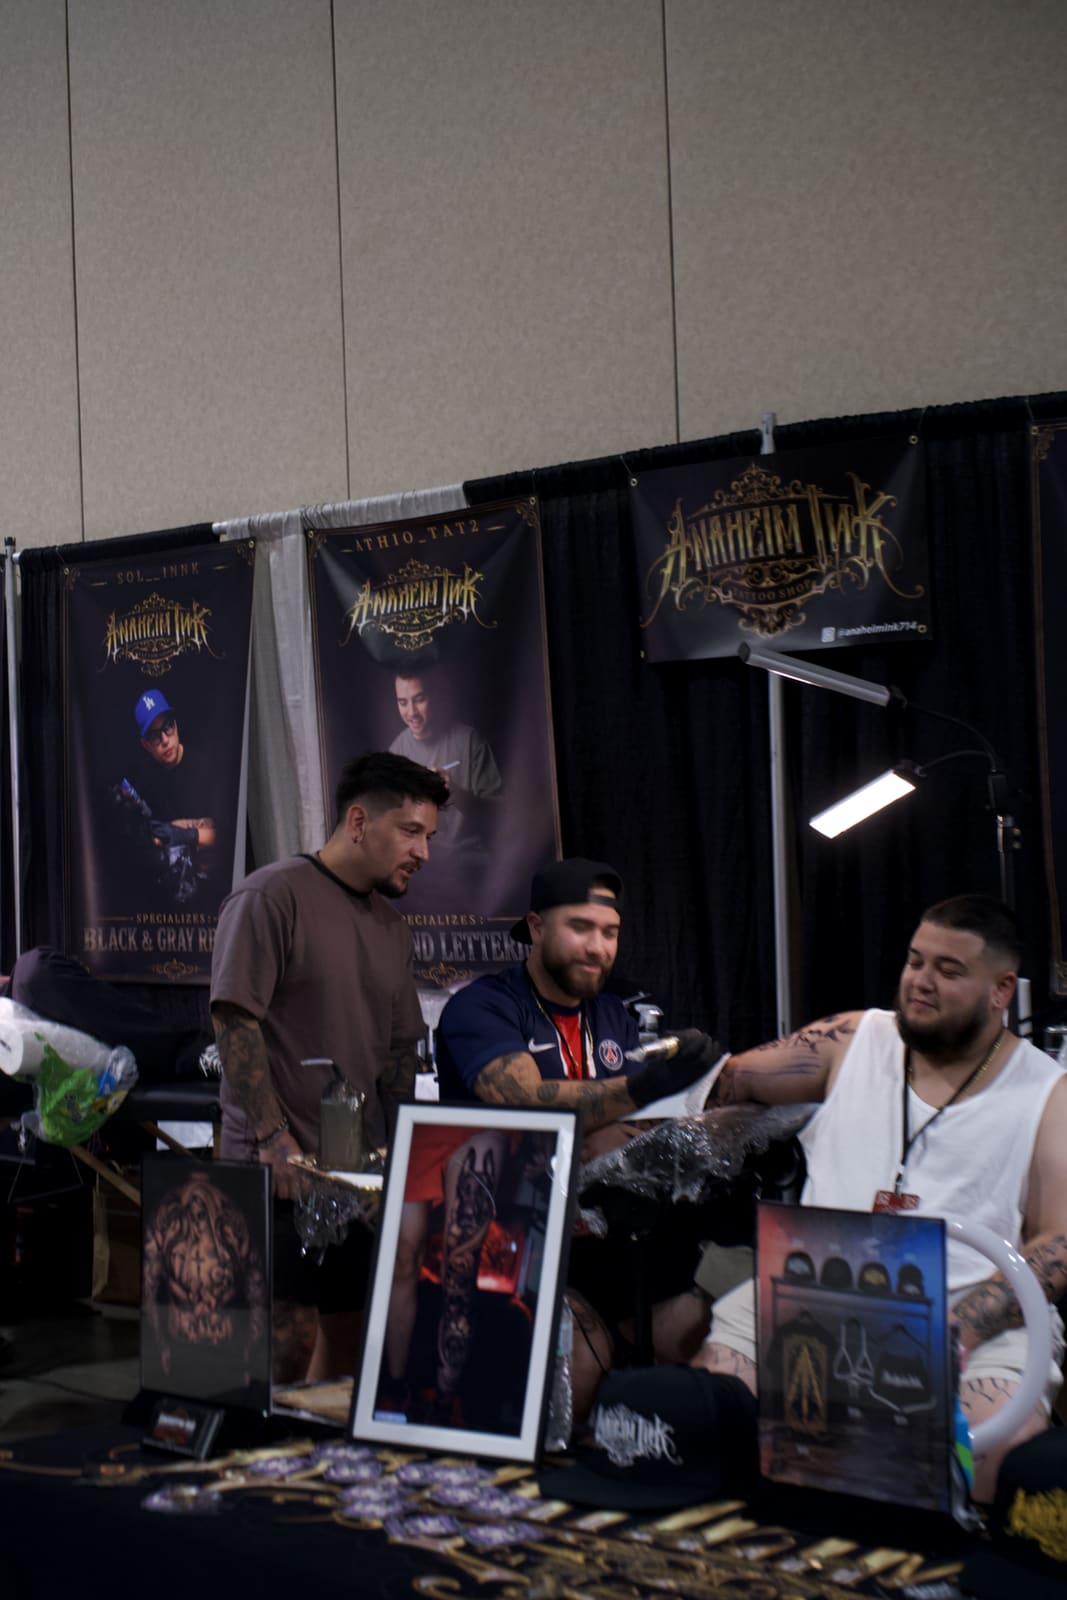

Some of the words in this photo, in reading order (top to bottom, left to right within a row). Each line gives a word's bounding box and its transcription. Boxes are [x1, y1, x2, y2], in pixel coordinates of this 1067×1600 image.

[84, 927, 138, 952] BLACK
[142, 930, 154, 952] &
[157, 927, 195, 952] GRAY
